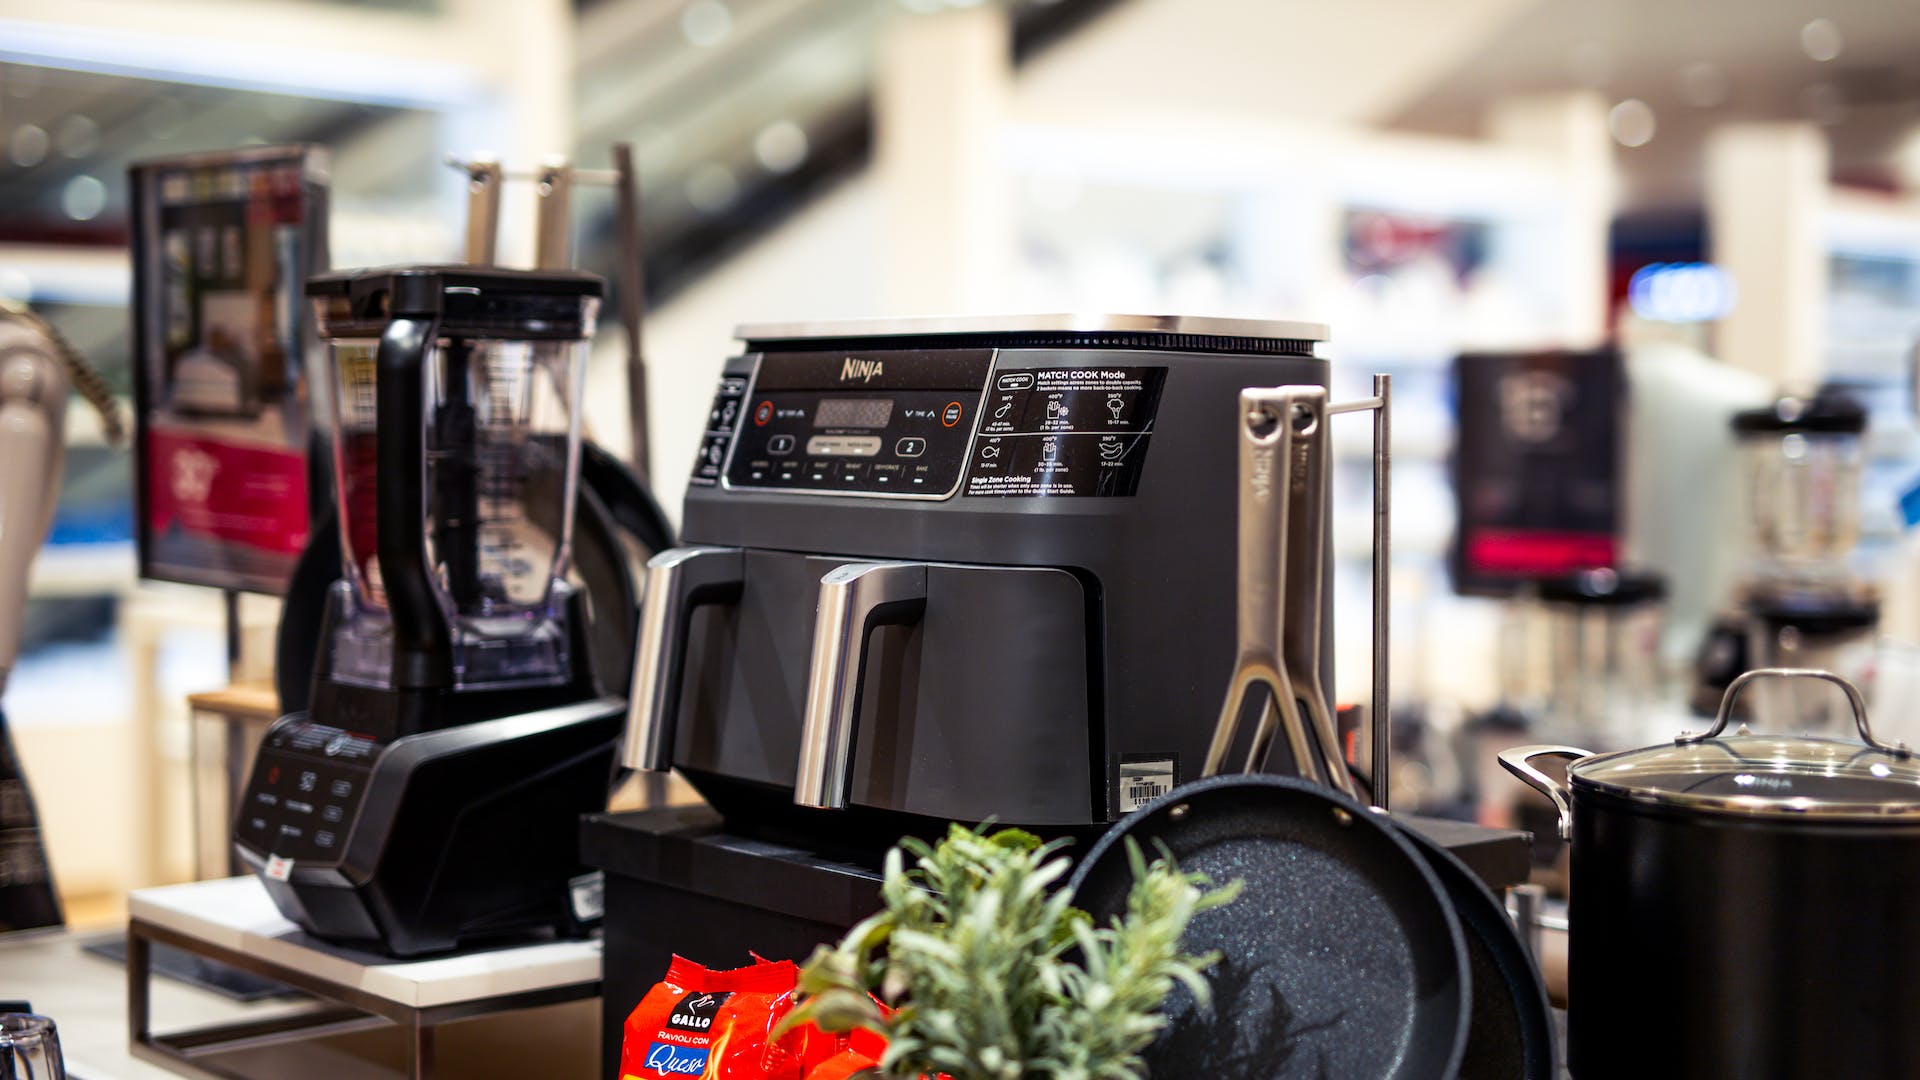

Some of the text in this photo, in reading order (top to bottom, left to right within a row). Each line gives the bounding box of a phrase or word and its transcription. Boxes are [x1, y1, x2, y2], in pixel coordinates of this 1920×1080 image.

[1038, 370, 1126, 380] MATCH COOK Mode
[906, 442, 914, 453] 2
[672, 1014, 711, 1028] GALLO
[658, 1030, 710, 1045] RAVIOLI CON
[645, 1044, 705, 1076] Queso
